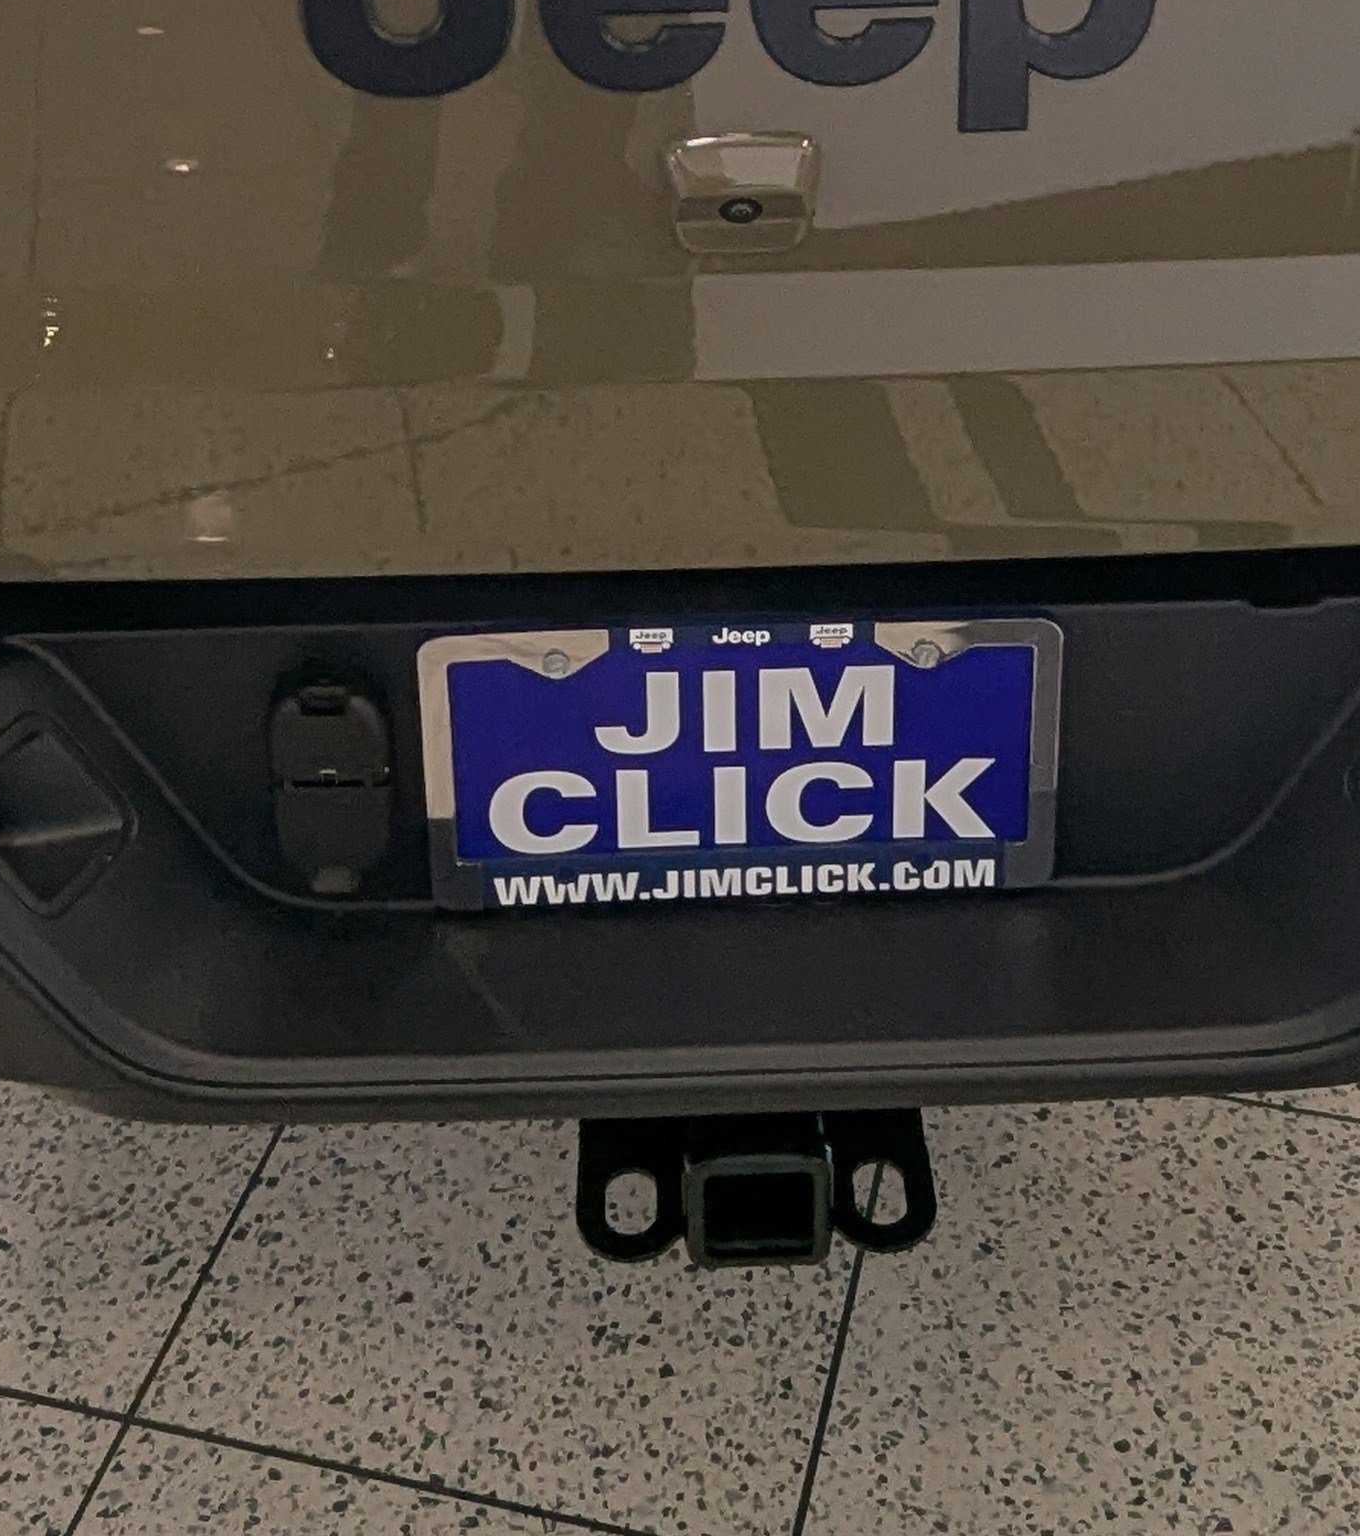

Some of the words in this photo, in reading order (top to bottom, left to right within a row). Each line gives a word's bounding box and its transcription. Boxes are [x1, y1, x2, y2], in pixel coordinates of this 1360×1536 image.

[634, 630, 667, 642] Jeep
[711, 627, 771, 647] Jeep
[815, 624, 849, 636] Jeep
[594, 664, 896, 755] JIM
[488, 757, 997, 855] CLICK
[492, 858, 996, 907] WWW.JIMCLICK.COM
